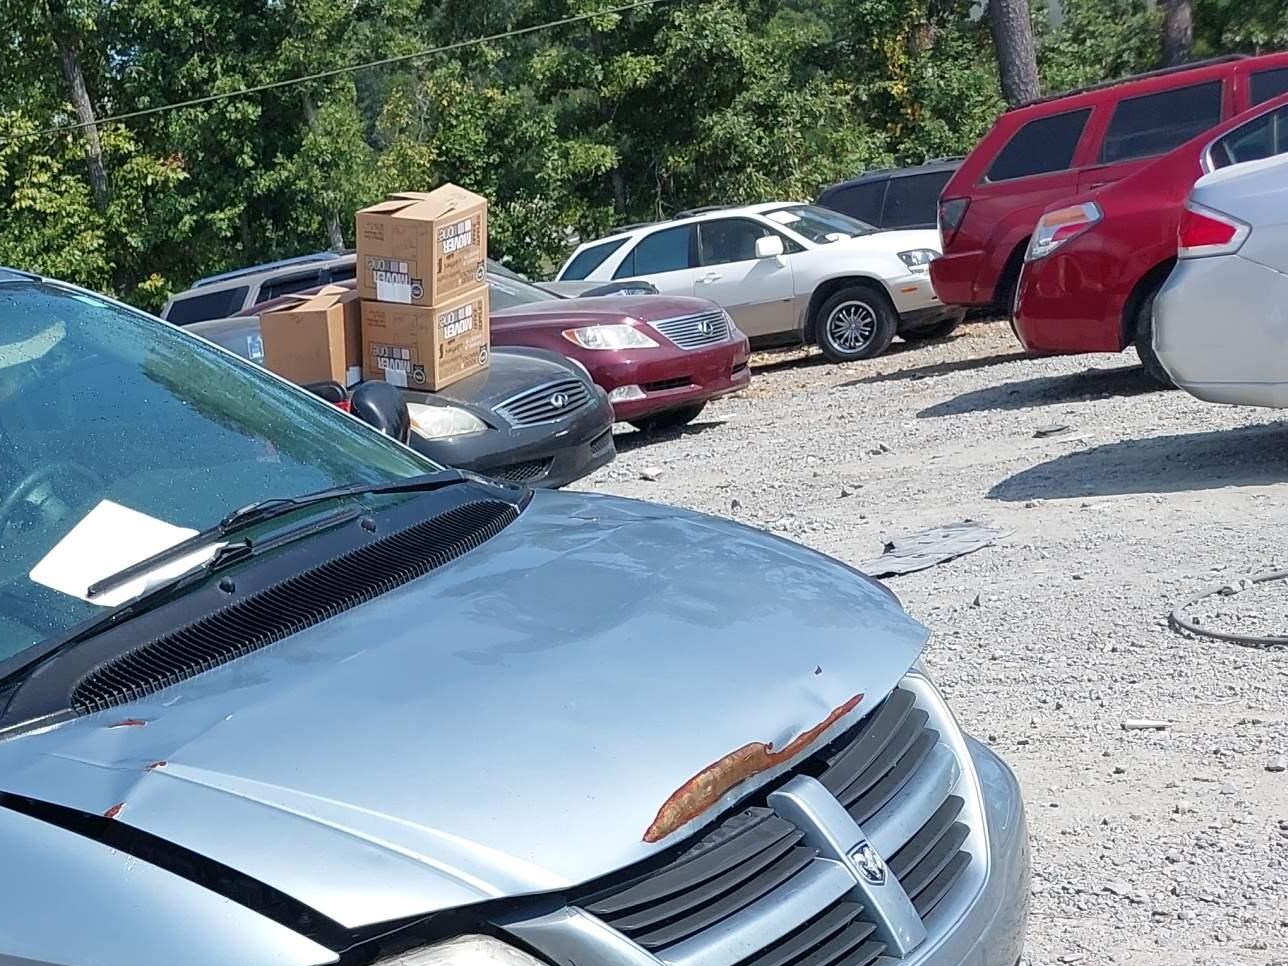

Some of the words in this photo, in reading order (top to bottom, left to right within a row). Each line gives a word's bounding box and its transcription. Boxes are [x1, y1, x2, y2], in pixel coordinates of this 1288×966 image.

[443, 231, 472, 254] MOVER
[444, 316, 472, 339] MOVER
[377, 357, 411, 373] MOVER
